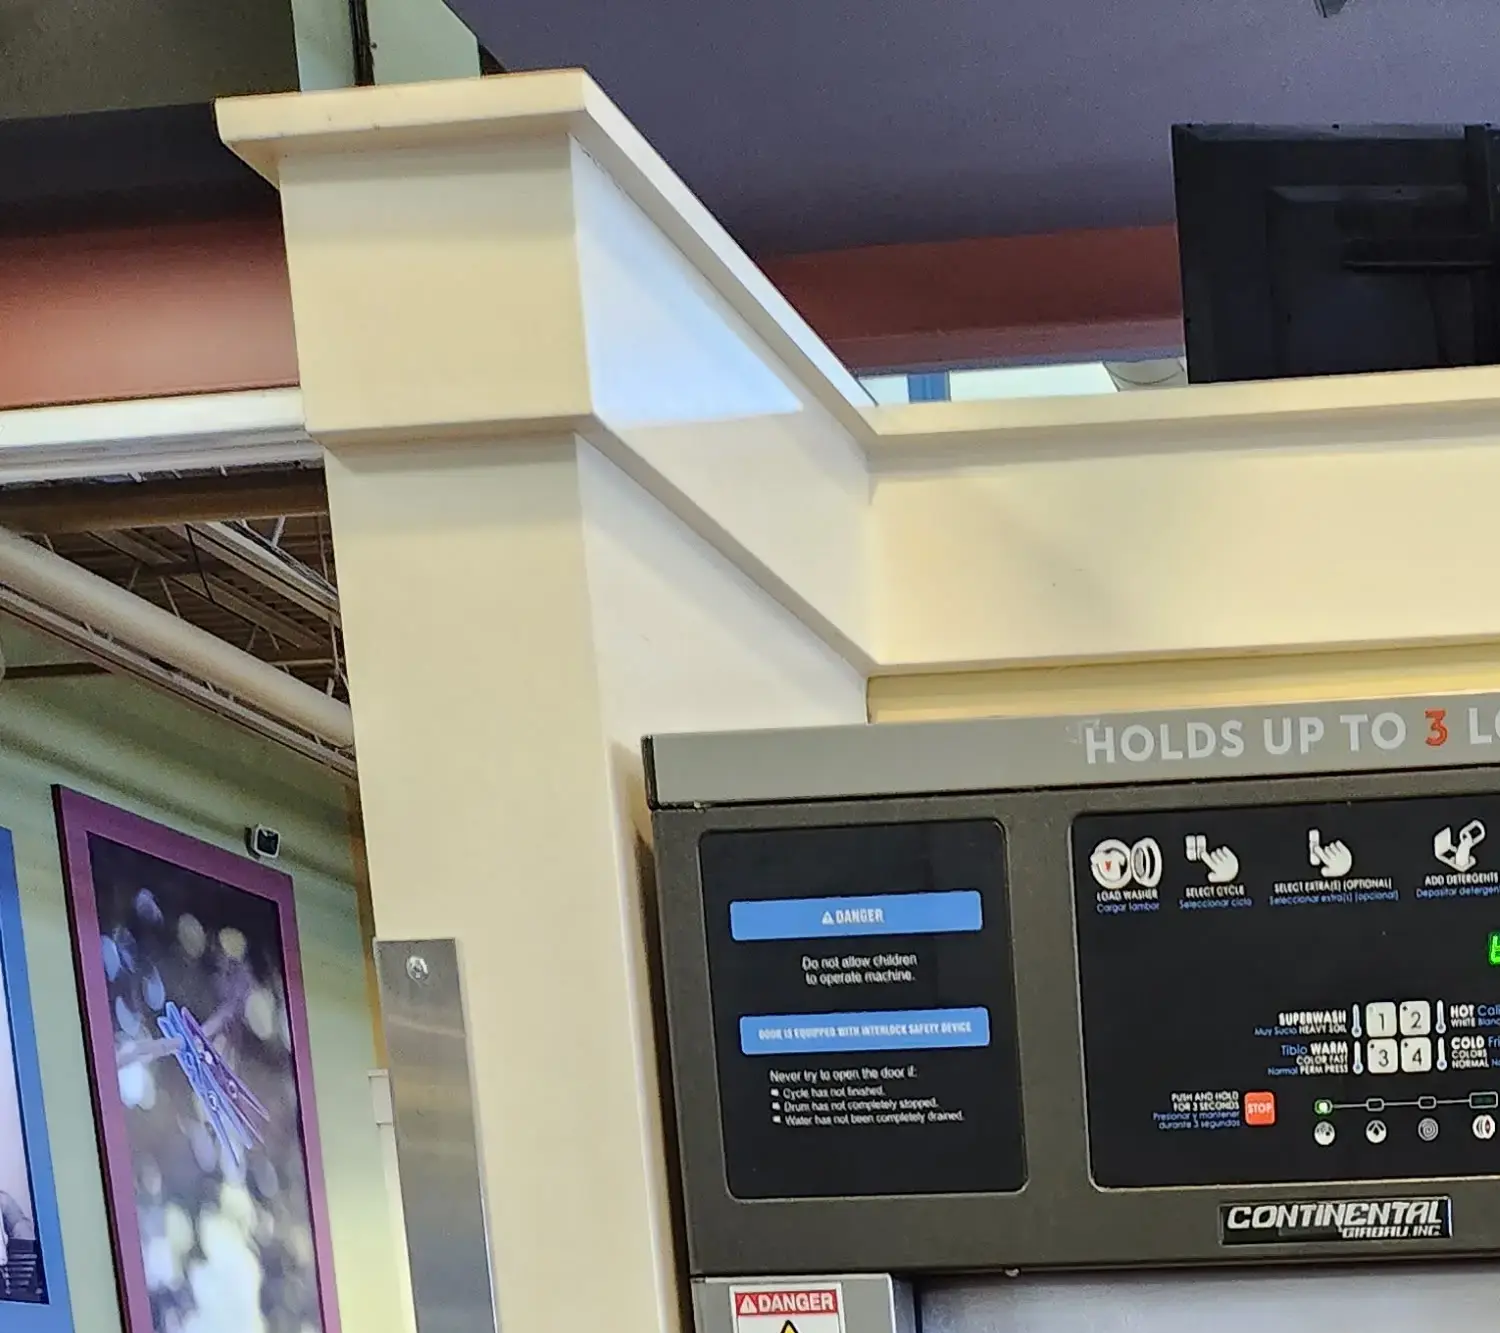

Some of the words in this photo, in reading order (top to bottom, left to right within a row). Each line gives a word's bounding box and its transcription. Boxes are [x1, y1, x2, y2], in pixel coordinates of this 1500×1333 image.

[1084, 716, 1244, 763] HOLDS
[1263, 715, 1325, 755] UP
[1340, 711, 1408, 753] TO
[1424, 709, 1450, 747] 3
[1425, 874, 1444, 885] ADD
[1447, 872, 1498, 884] DETERGENTS
[1416, 886, 1457, 898] Depositar
[836, 908, 884, 924] DANGER
[1279, 1010, 1346, 1026] SUPERWASH
[1451, 1004, 1474, 1018] HOT
[1378, 1014, 1384, 1030] 1
[1411, 1012, 1422, 1029] 2
[1451, 1018, 1476, 1027] WHITE
[1451, 1036, 1485, 1049] COLD
[1378, 1049, 1389, 1067] 3
[1412, 1048, 1422, 1065] 4
[1452, 1048, 1487, 1059] COLORS
[1452, 1057, 1489, 1069] NORMAL
[1247, 1102, 1273, 1114] STOP
[1227, 1200, 1442, 1229] CONTINENTAL
[1413, 1225, 1441, 1236] INC.
[758, 1292, 834, 1313] DANGER
